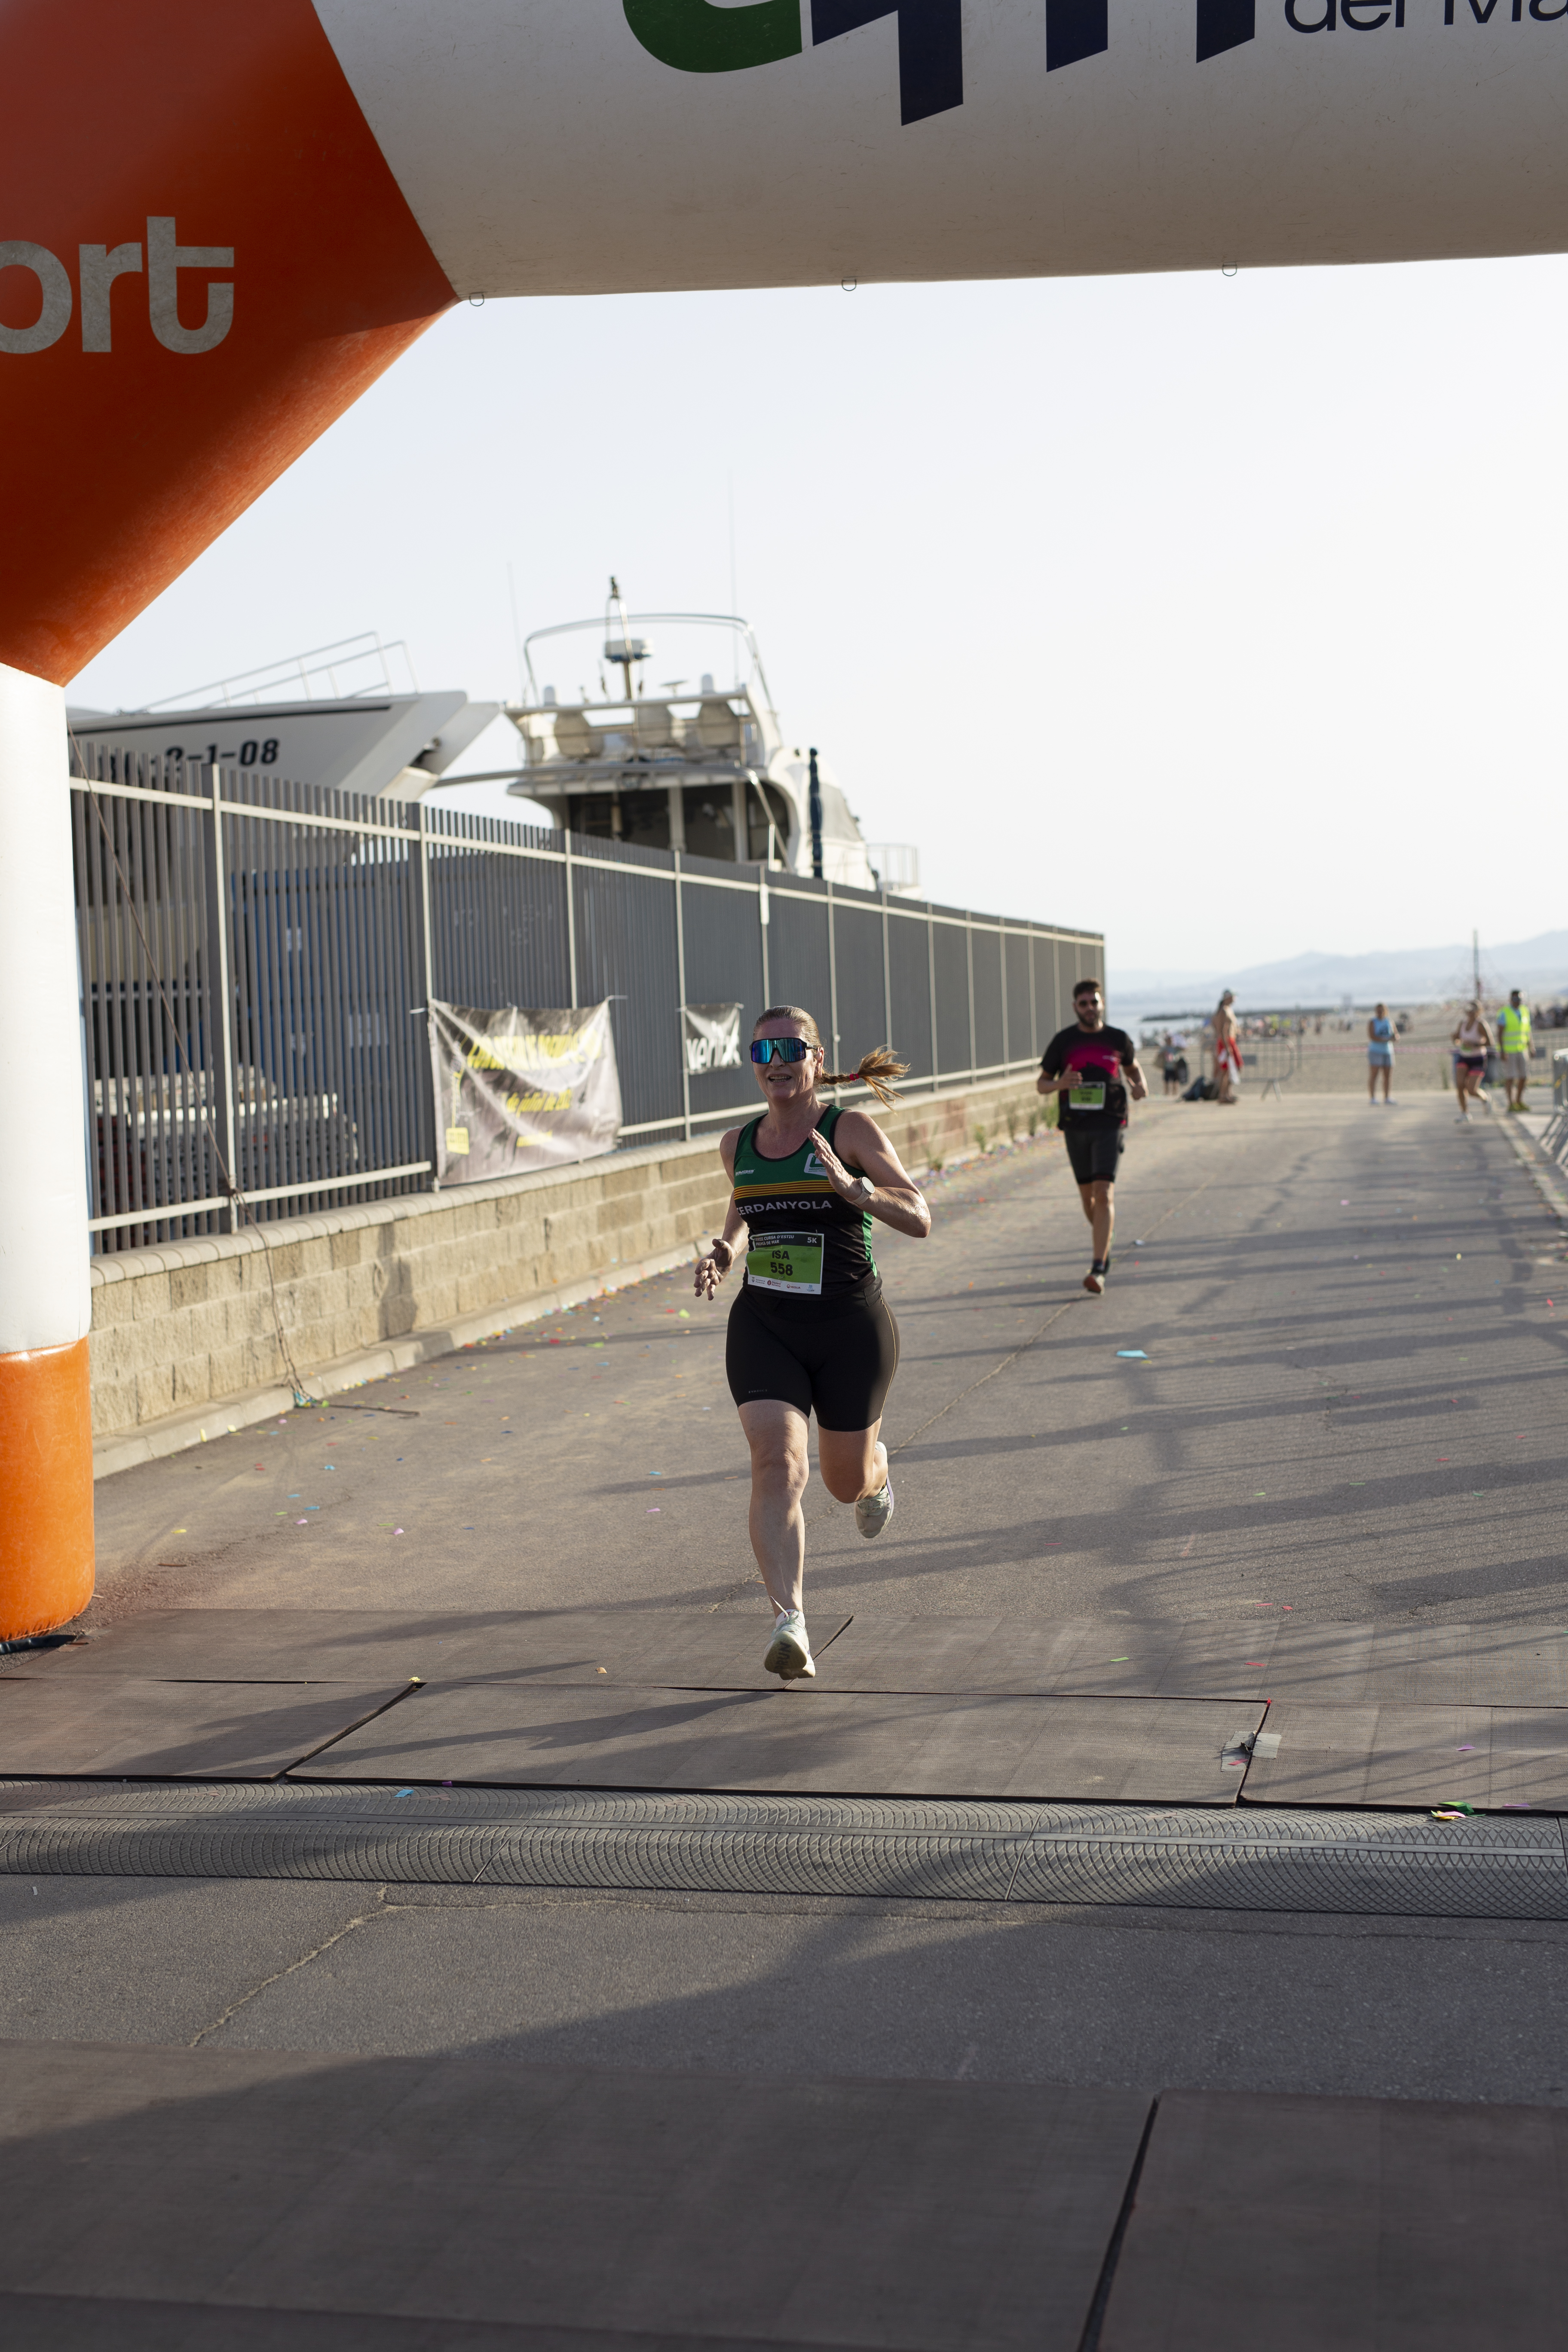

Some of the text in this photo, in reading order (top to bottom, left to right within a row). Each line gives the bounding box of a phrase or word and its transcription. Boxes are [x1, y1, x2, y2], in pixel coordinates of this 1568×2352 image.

[736, 1200, 832, 1216] CERDANYOLA
[772, 1250, 790, 1260] ISA
[770, 1262, 793, 1276] 558
